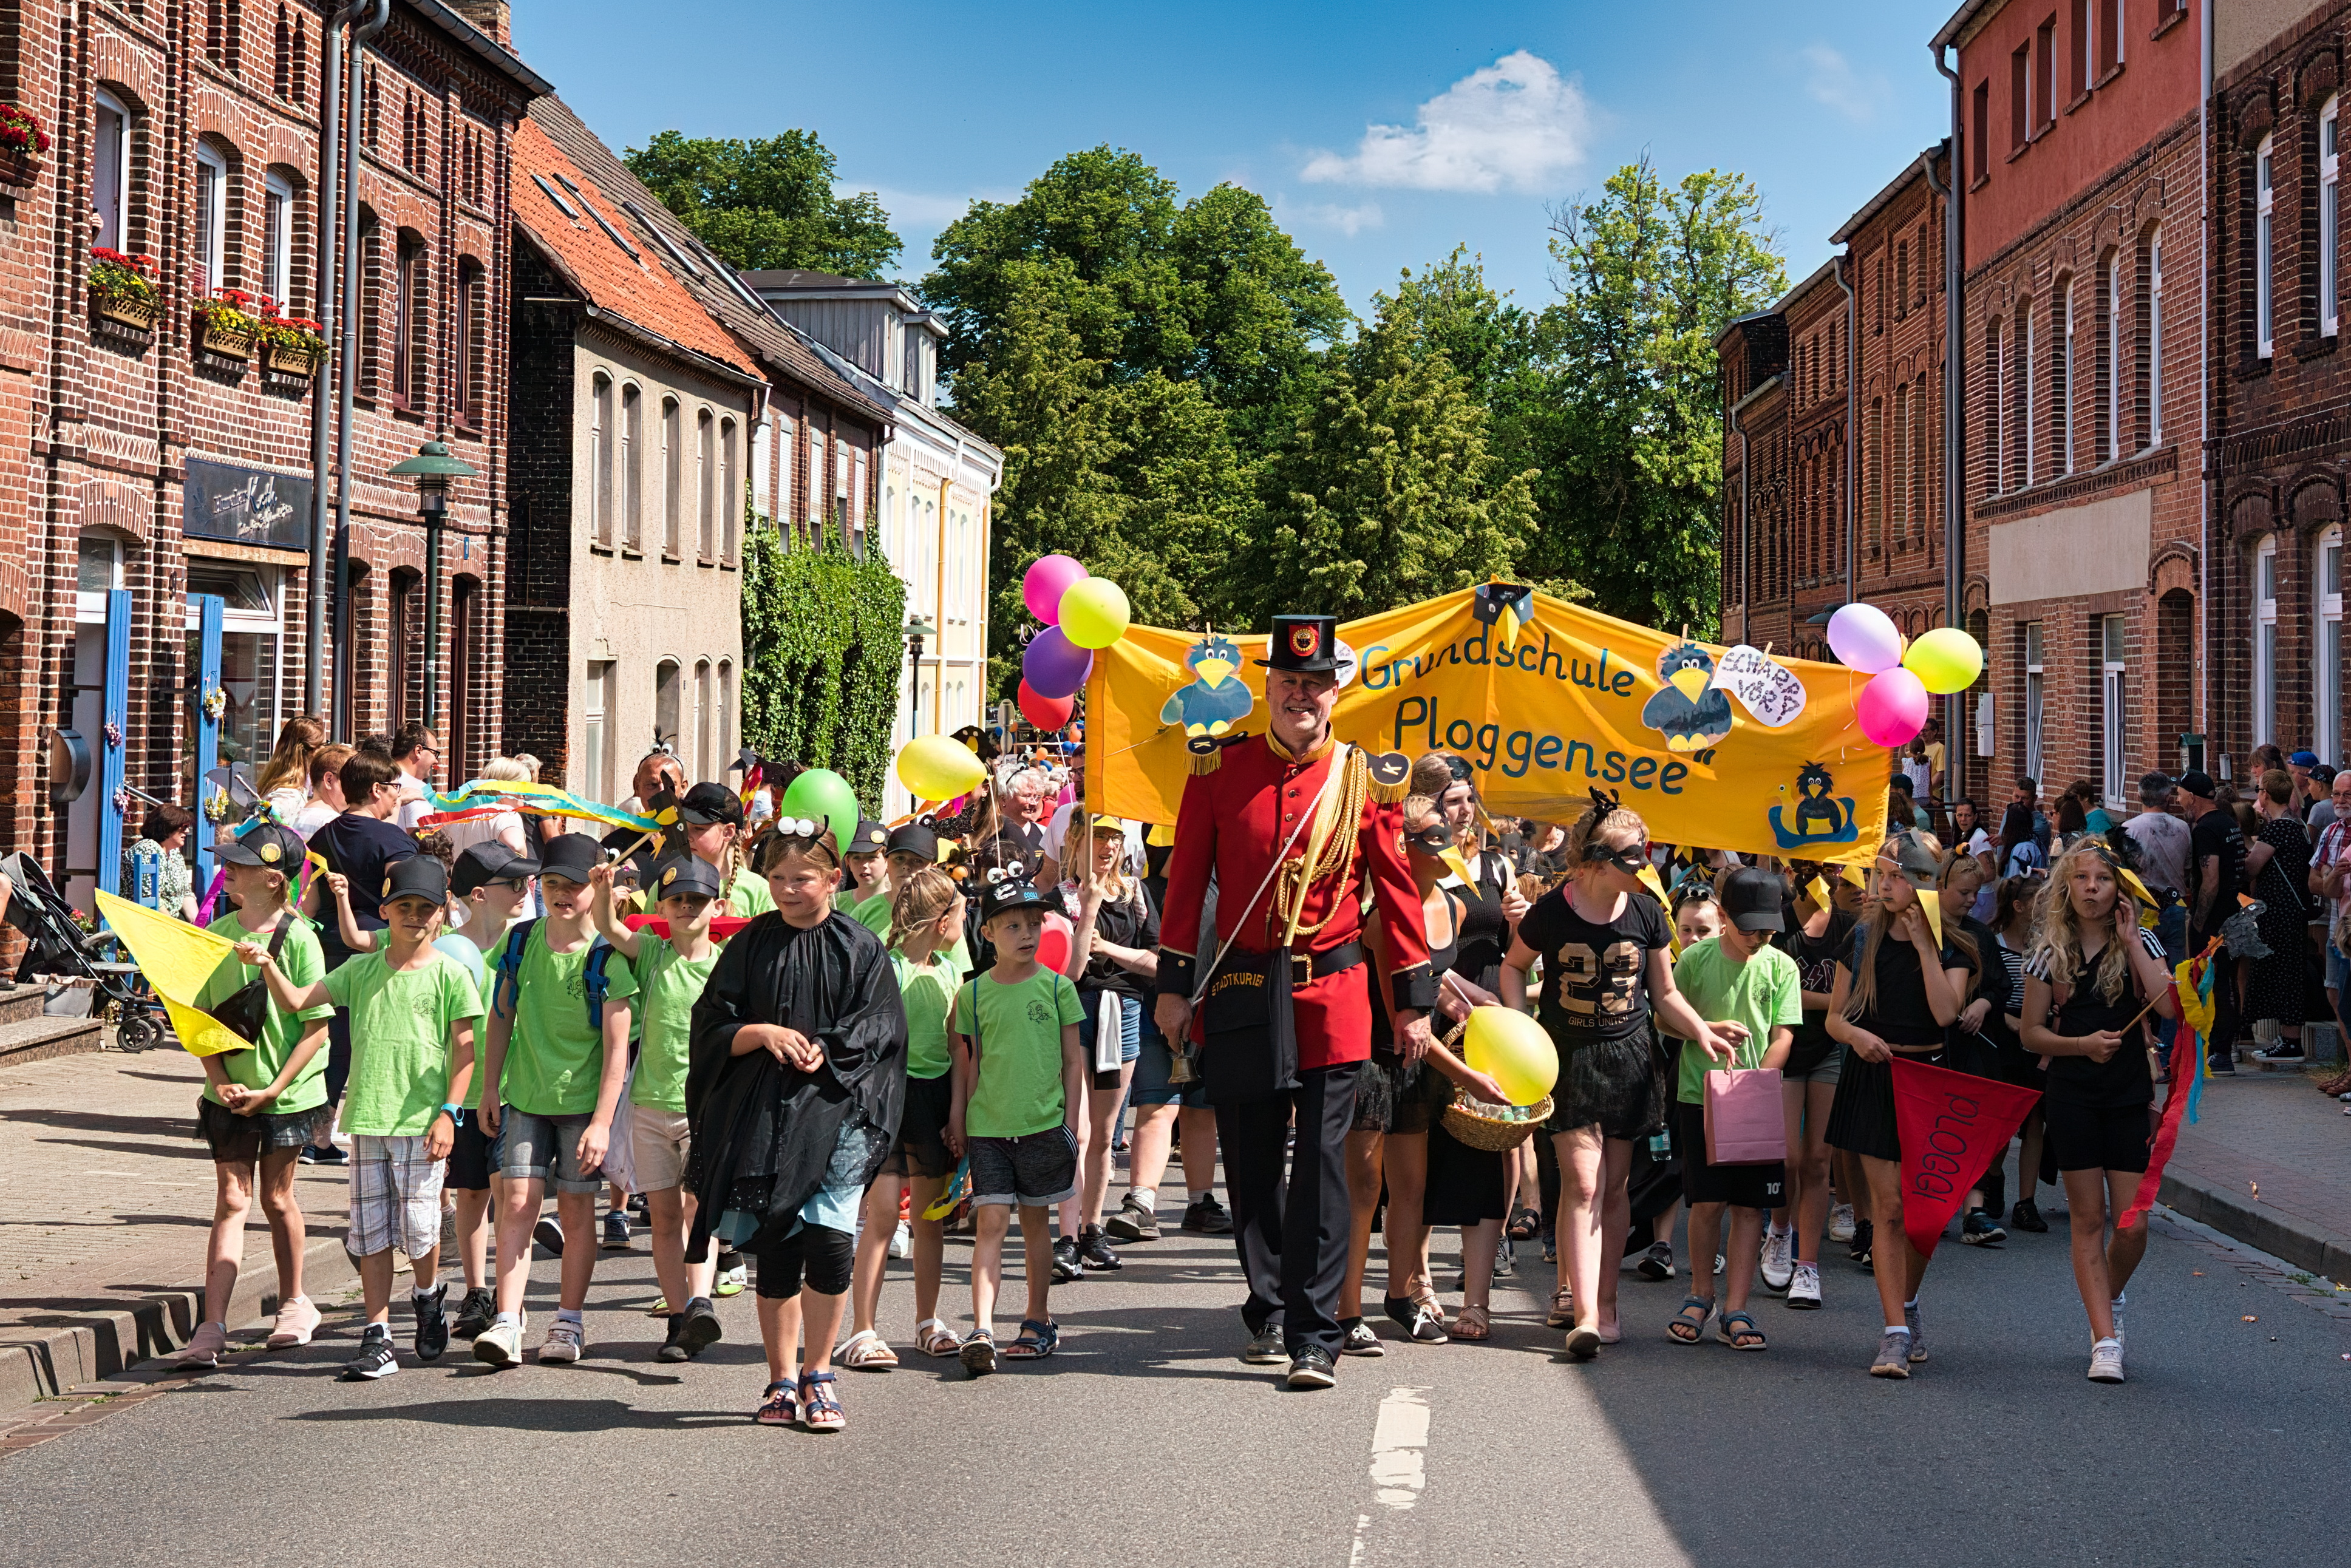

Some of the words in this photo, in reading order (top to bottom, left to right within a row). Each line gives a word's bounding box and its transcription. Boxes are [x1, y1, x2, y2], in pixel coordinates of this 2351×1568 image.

[1361, 622, 1635, 697] Grundschule
[1381, 761, 1403, 776] K
[29, 937, 38, 951] Joie
[1211, 972, 1265, 996] STADTKURIER
[1558, 941, 1642, 1019] 23
[1568, 1016, 1595, 1027] GIRLS
